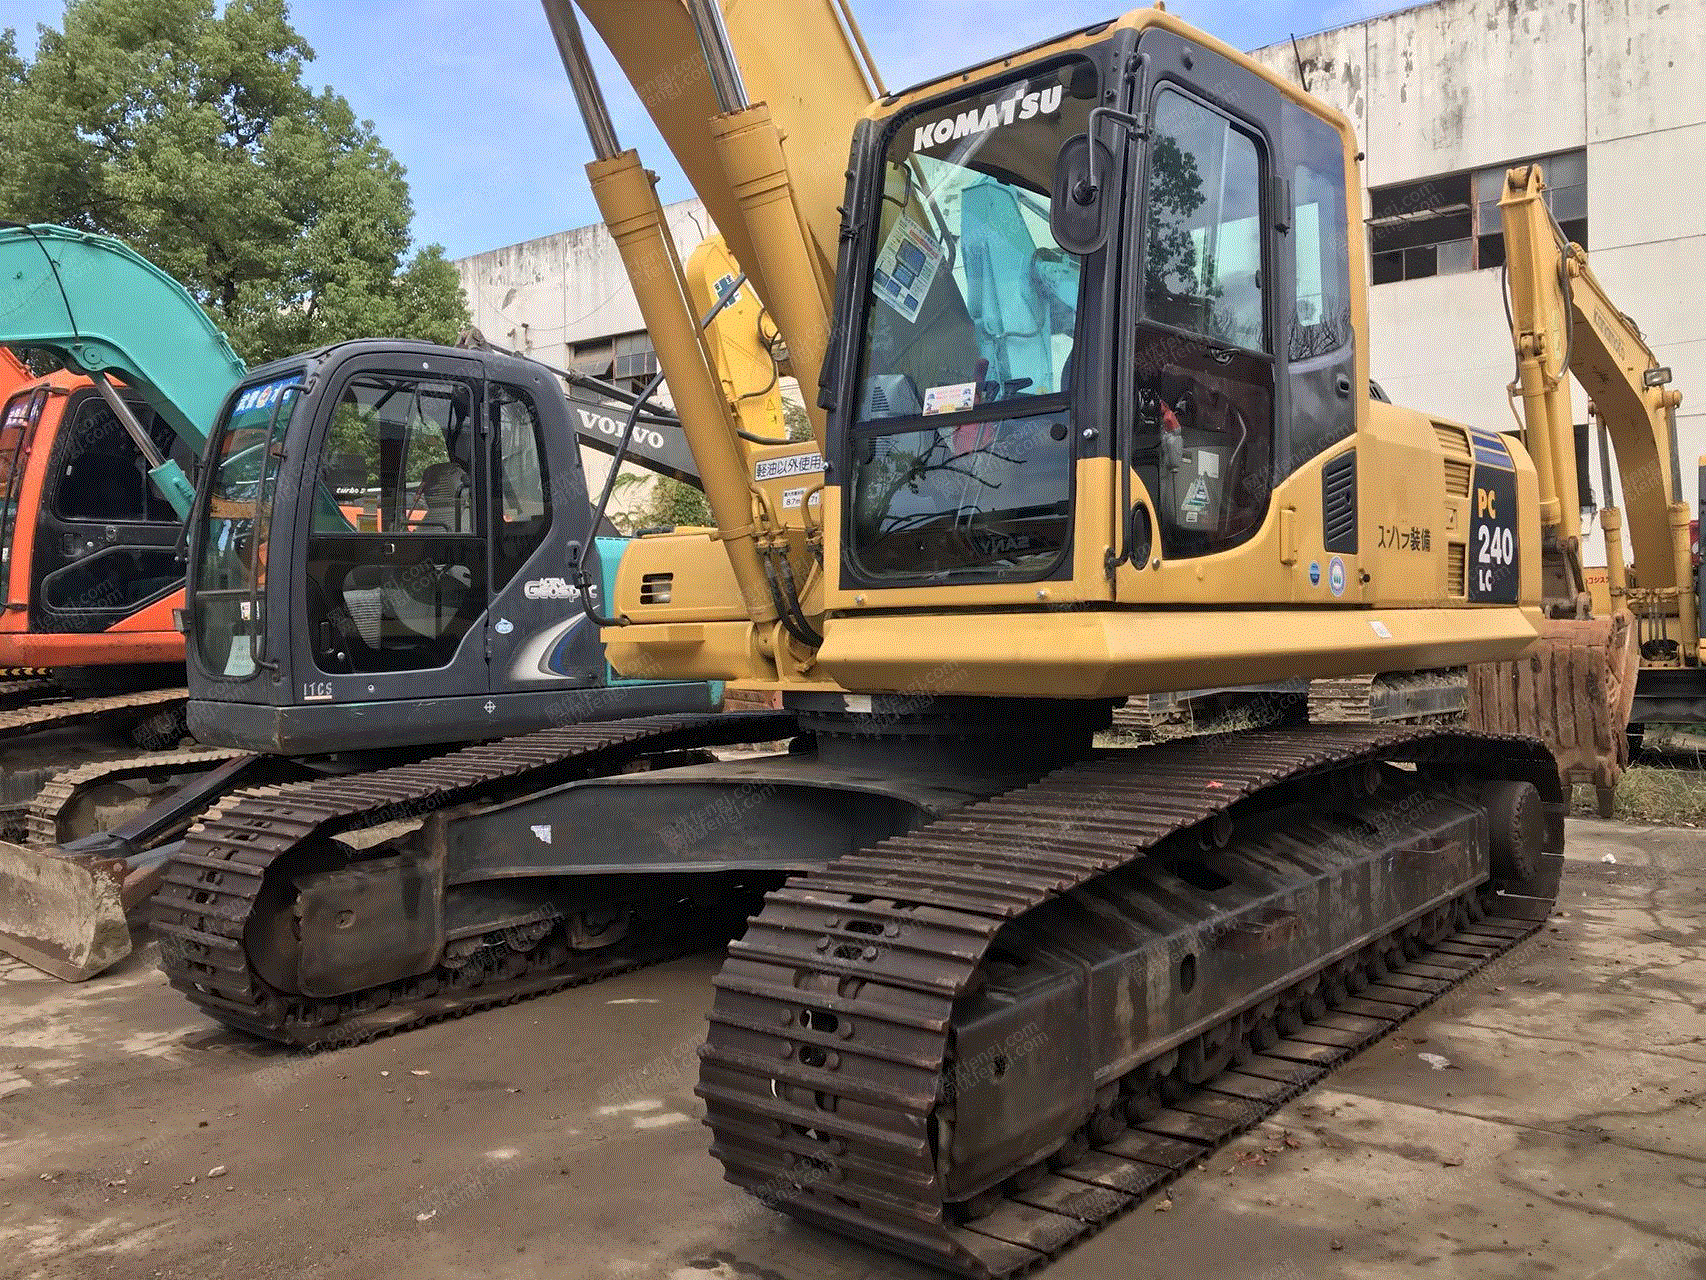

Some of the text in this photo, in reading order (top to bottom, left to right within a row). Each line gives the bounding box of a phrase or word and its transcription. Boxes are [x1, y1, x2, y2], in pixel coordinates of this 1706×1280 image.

[913, 84, 1063, 152] KOMATSU
[1477, 488, 1496, 519] PC
[1478, 525, 1513, 565] 240
[524, 580, 598, 603] Geospc
[1478, 569, 1492, 592] LC
